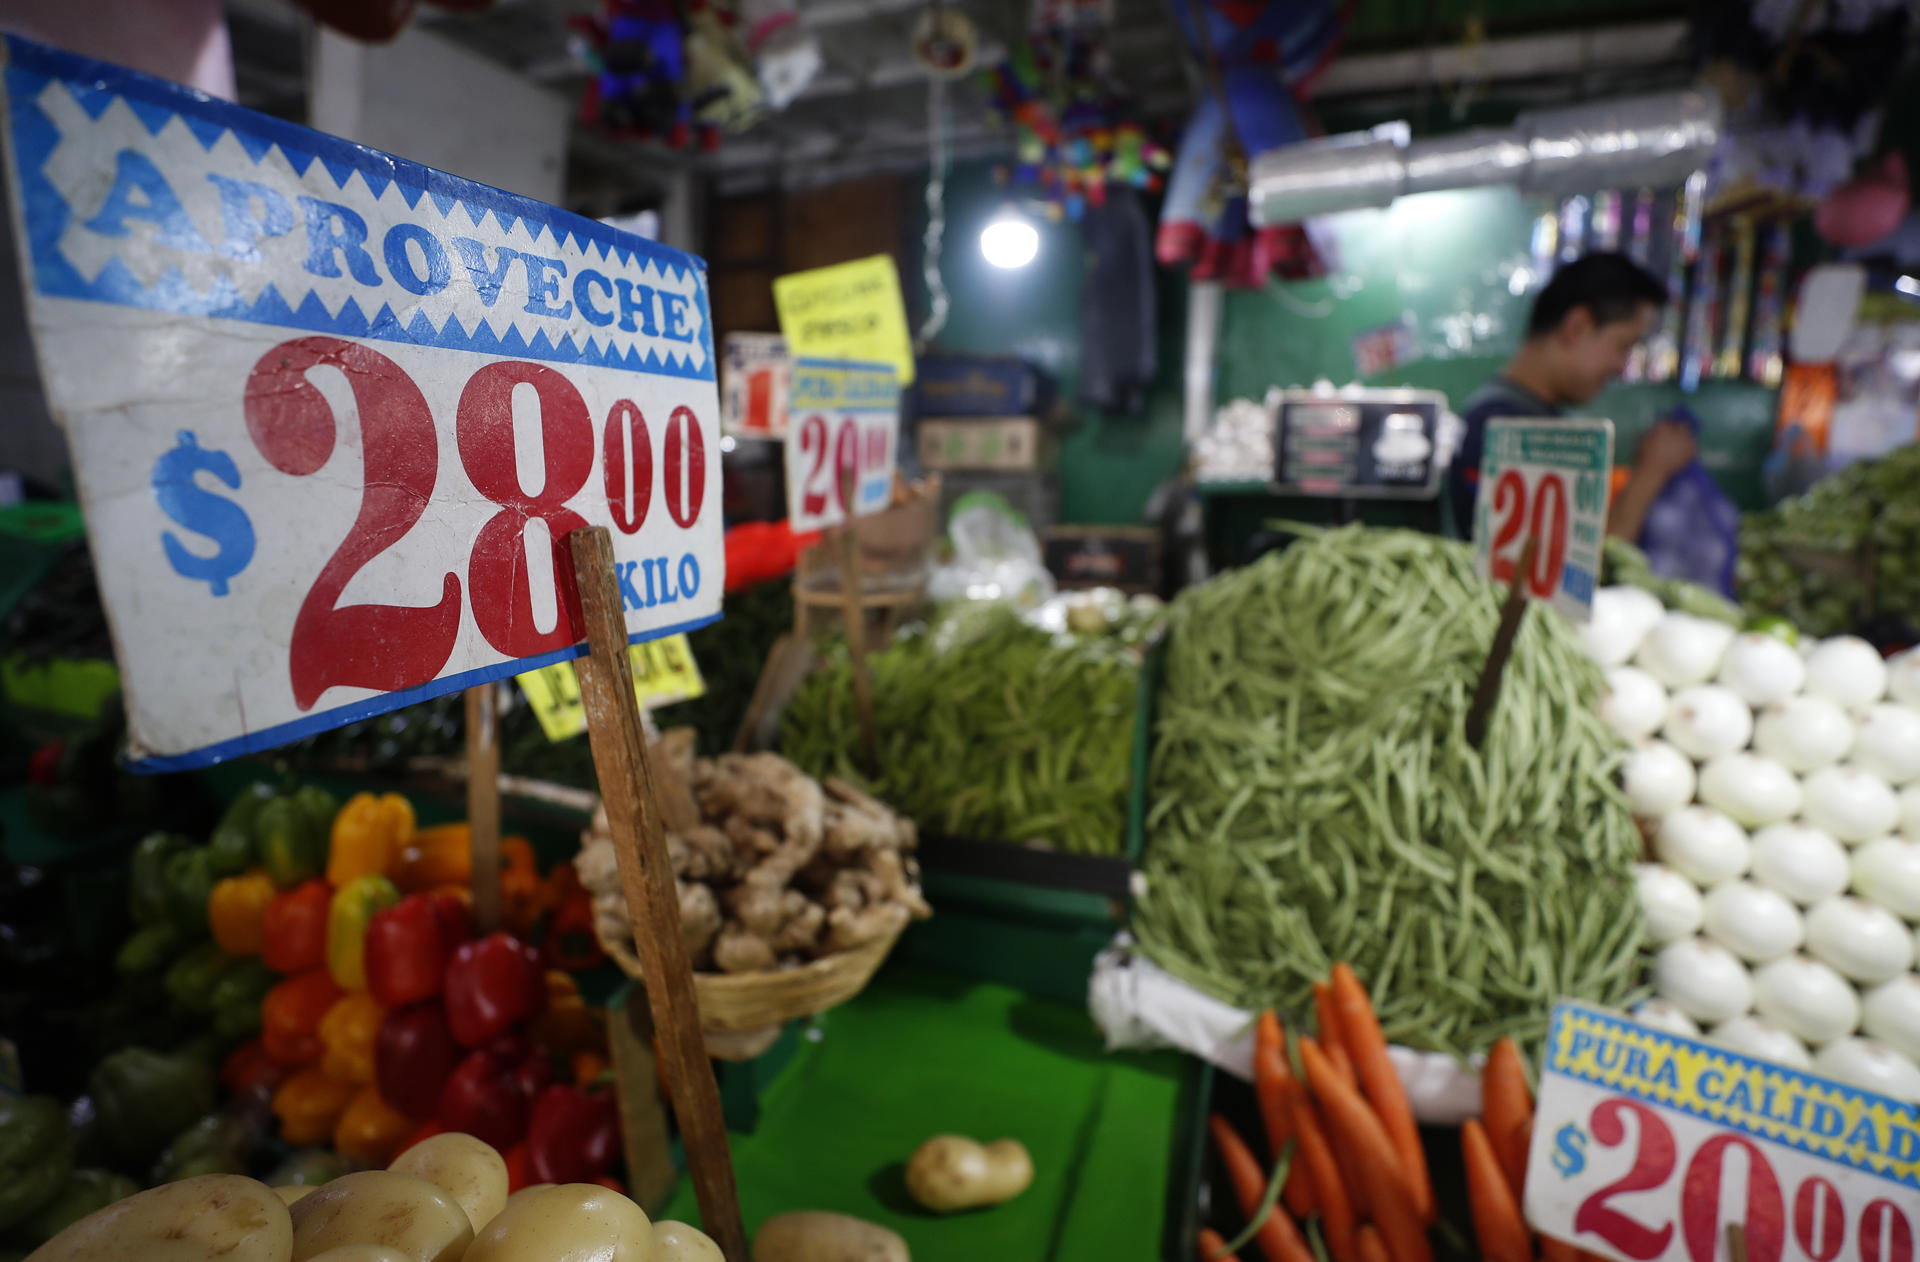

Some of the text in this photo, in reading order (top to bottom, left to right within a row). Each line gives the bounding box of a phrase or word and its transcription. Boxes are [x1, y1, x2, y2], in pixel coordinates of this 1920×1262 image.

[84, 149, 694, 344] APROVECHE
[152, 430, 256, 596] $
[1491, 467, 1568, 598] 20
[615, 553, 700, 612] KILO
[1551, 1122, 1588, 1178] $
[1568, 1028, 1920, 1165] PURA CALIDAD
